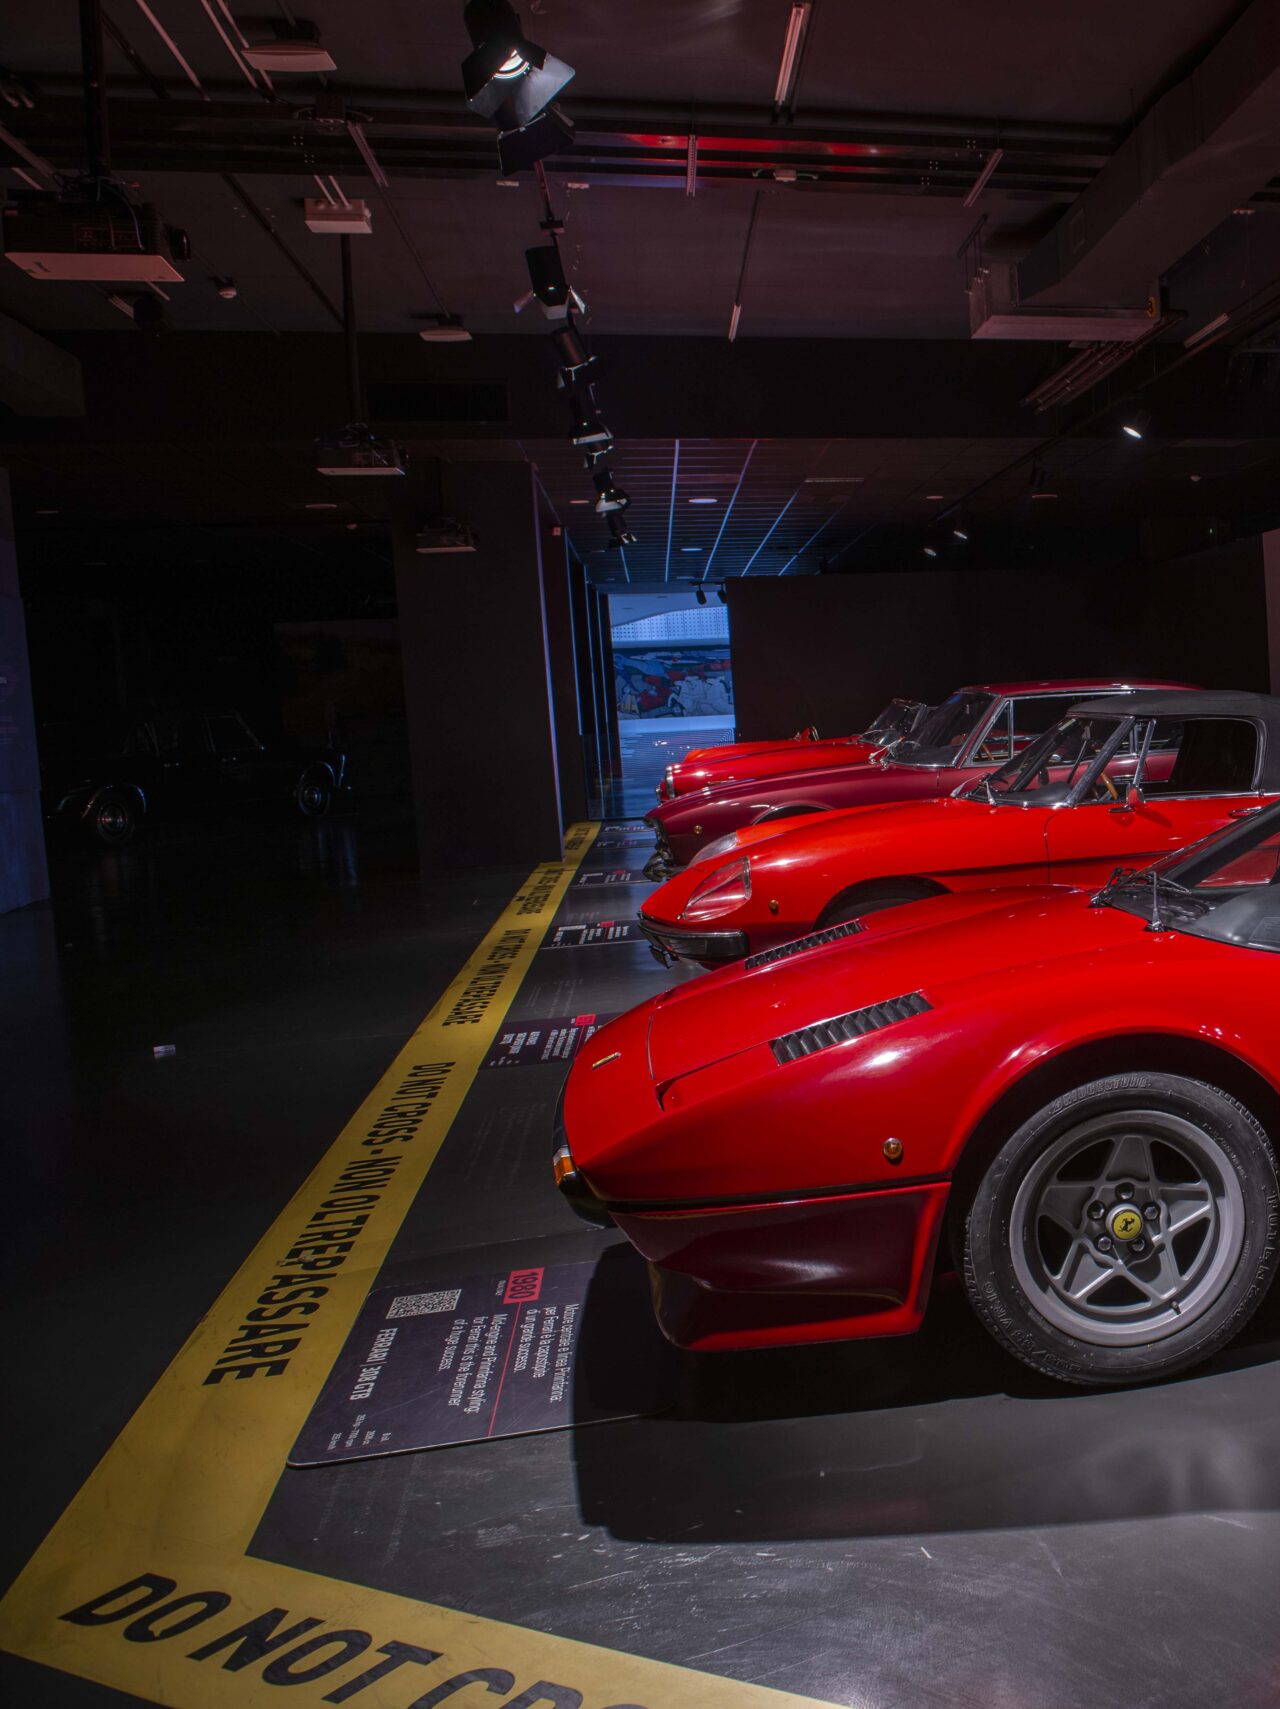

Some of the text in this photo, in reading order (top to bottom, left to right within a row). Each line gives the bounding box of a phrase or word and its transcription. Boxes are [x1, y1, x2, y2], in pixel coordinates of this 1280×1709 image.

[407, 1061, 456, 1080] DO
[390, 1076, 448, 1101] NOT
[361, 1102, 432, 1147] CROSS
[329, 1155, 403, 1194] NON
[202, 1194, 381, 1386] OLTREPASSARE
[509, 1272, 538, 1299] 1980
[473, 1316, 488, 1324] for
[524, 1314, 537, 1323] un
[543, 1306, 557, 1316] per
[563, 1303, 580, 1324] Motore
[467, 1324, 486, 1343] Ferrari
[485, 1313, 508, 1345] Mid-engine
[520, 1323, 536, 1343] grande
[542, 1315, 559, 1334] Ferrari
[559, 1324, 574, 1347] centrale
[445, 1330, 463, 1345] huge
[463, 1343, 480, 1354] this
[438, 1346, 457, 1372] success.
[482, 1345, 498, 1357] and
[513, 1343, 531, 1373] successo.
[555, 1351, 572, 1367] linea
[349, 1327, 398, 1401] FERRARI 308 GTB
[458, 1361, 474, 1372] the
[473, 1356, 497, 1389] Pininfarina
[448, 1372, 472, 1406] forerunner
[57, 1572, 232, 1643] DO
[185, 1607, 444, 1705] NOT
